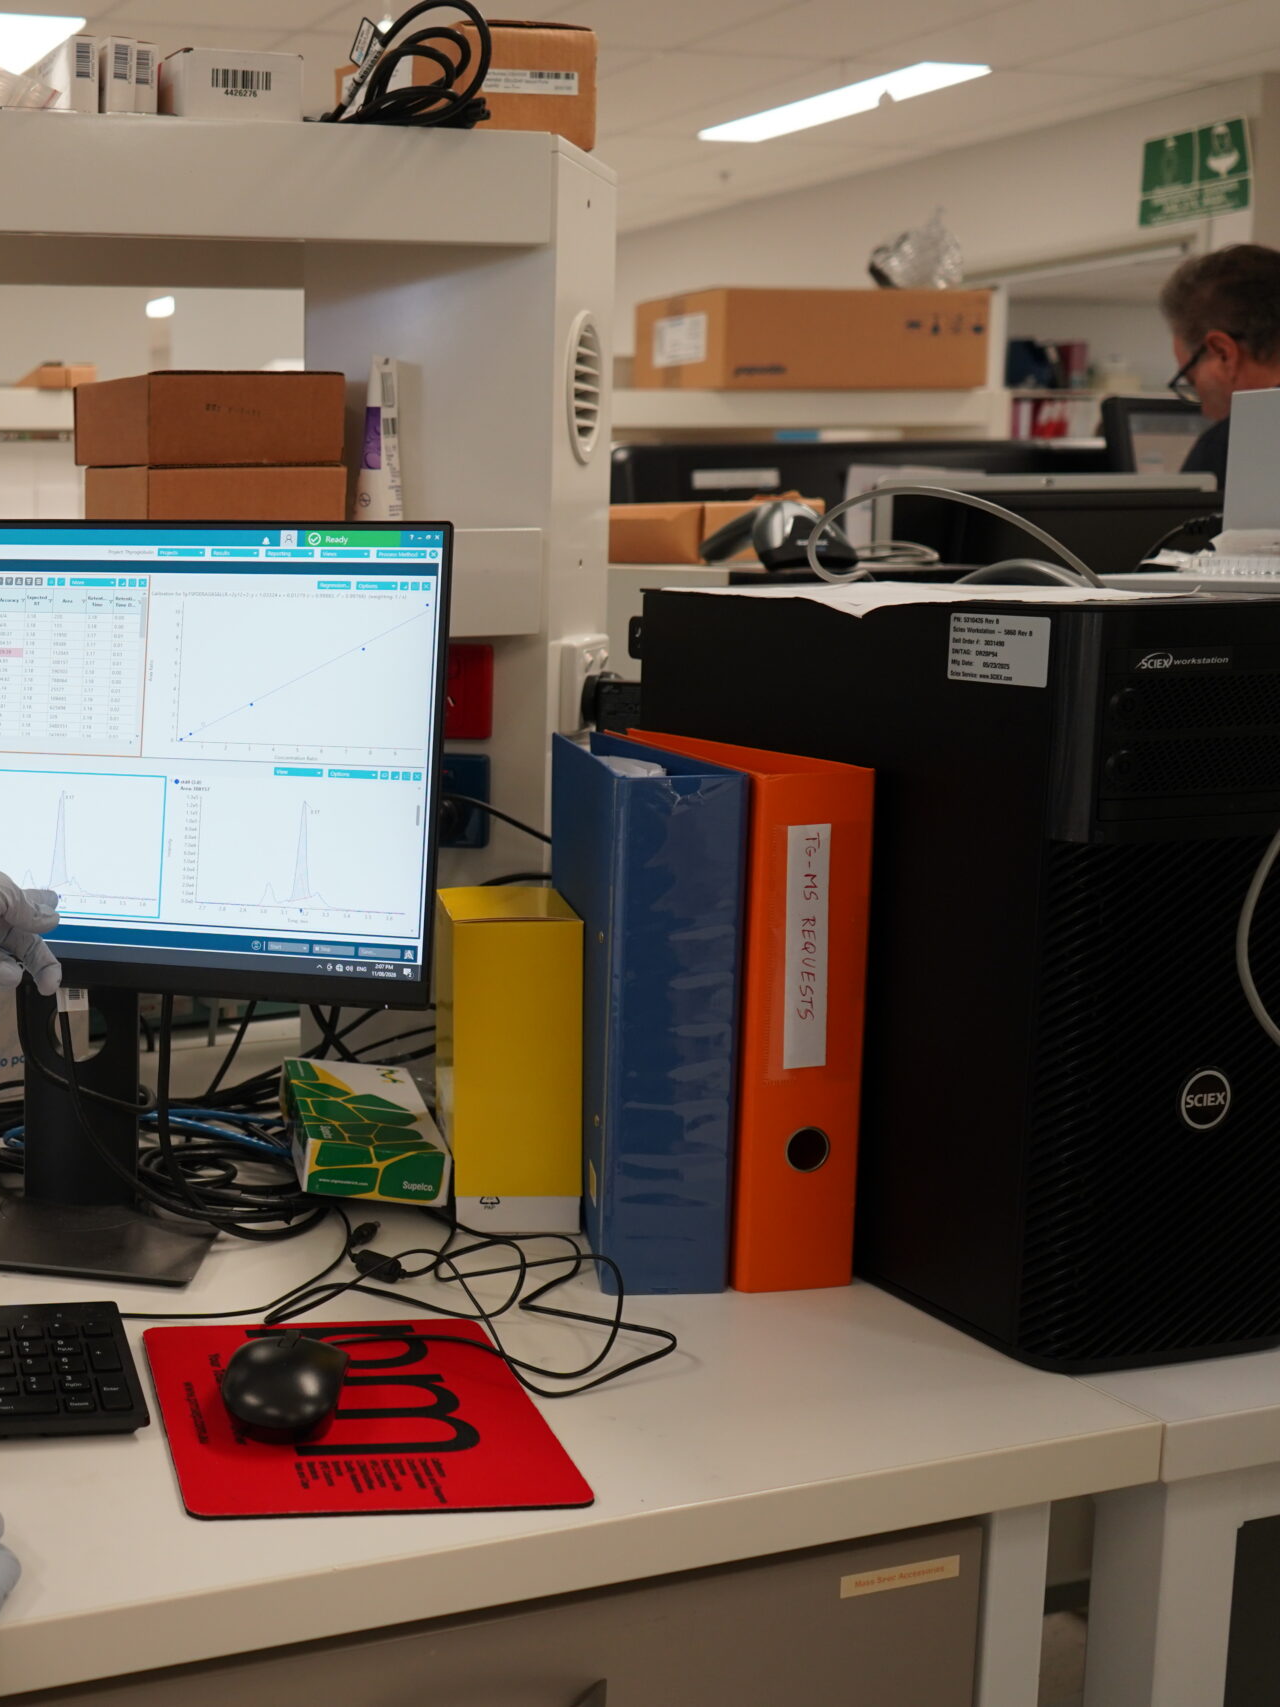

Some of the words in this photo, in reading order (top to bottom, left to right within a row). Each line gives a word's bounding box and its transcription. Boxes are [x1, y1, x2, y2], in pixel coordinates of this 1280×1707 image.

[224, 89, 258, 97] 4426276
[325, 536, 348, 545] Ready
[1141, 658, 1169, 669] SCIEX
[1174, 656, 1229, 665] workstation
[796, 915, 817, 1021] REQUESTS
[1185, 1091, 1226, 1108] SCIEX
